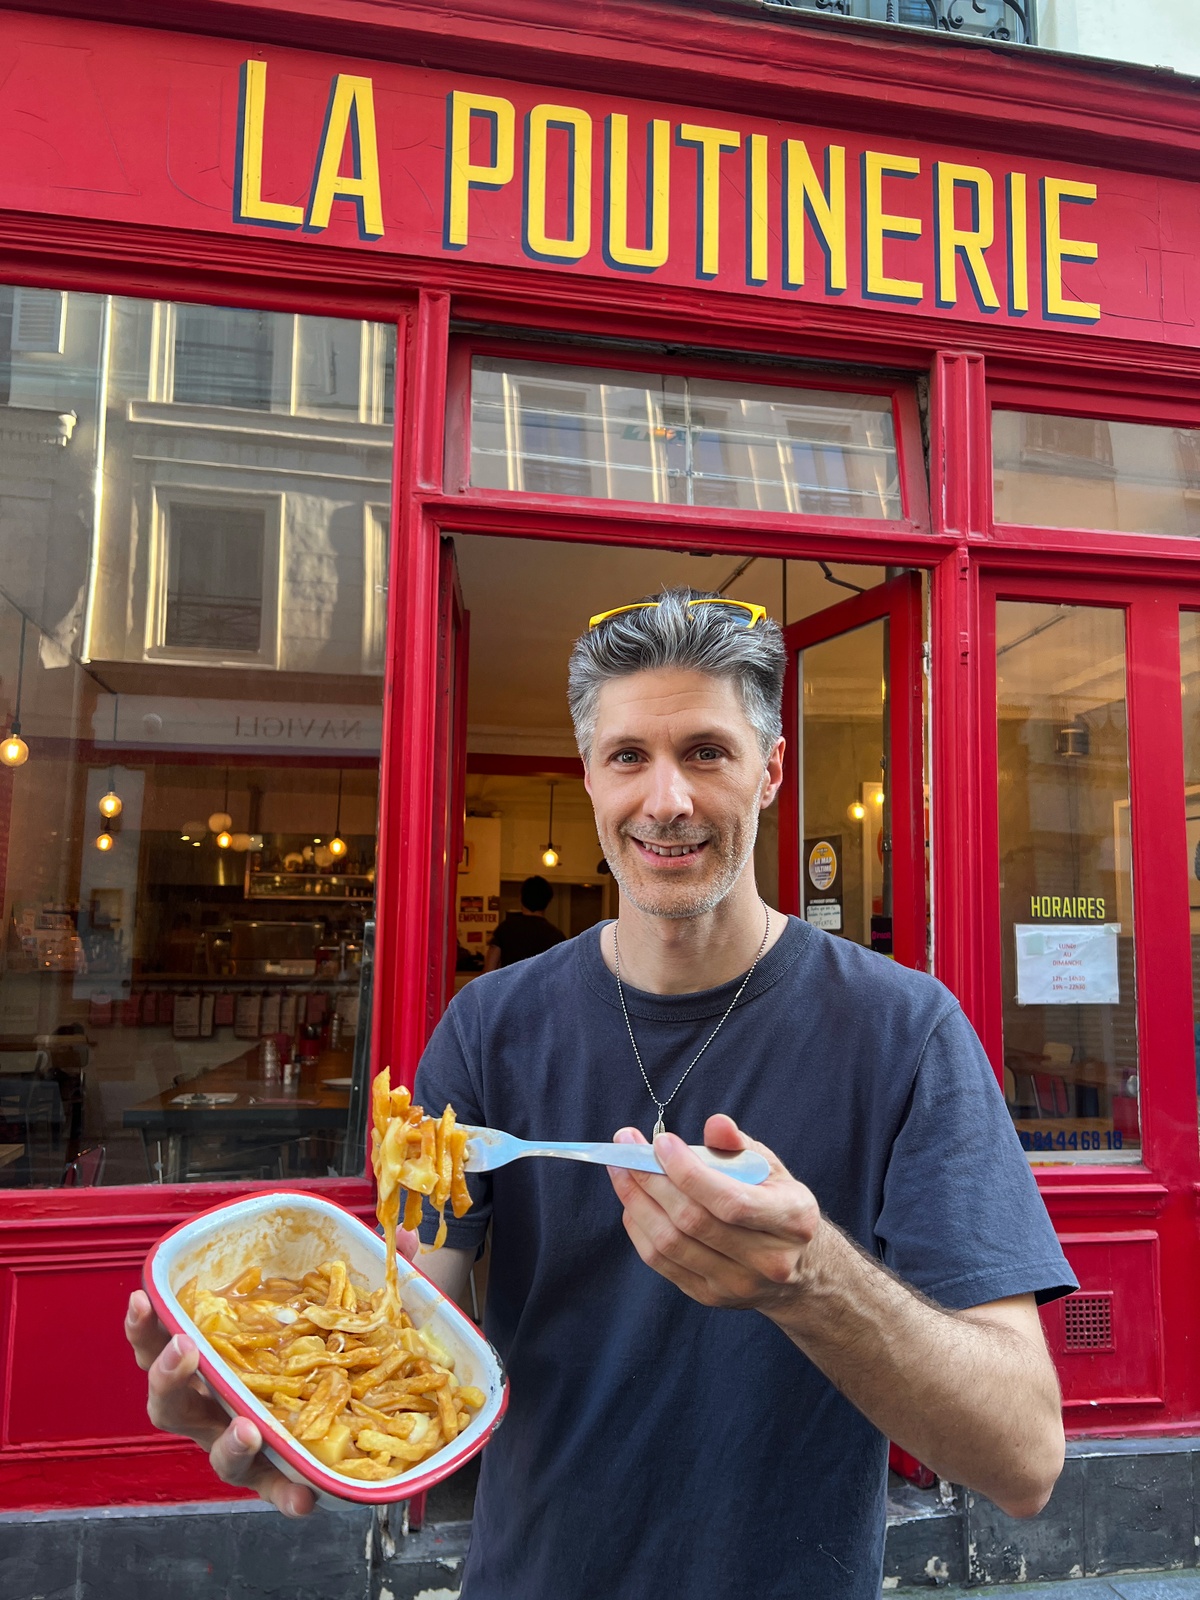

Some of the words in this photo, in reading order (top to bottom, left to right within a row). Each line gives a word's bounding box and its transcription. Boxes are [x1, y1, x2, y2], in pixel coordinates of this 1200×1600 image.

[233, 60, 384, 241] LA
[443, 90, 1101, 326] POUTINERIE
[1031, 896, 1105, 919] HORAIRES
